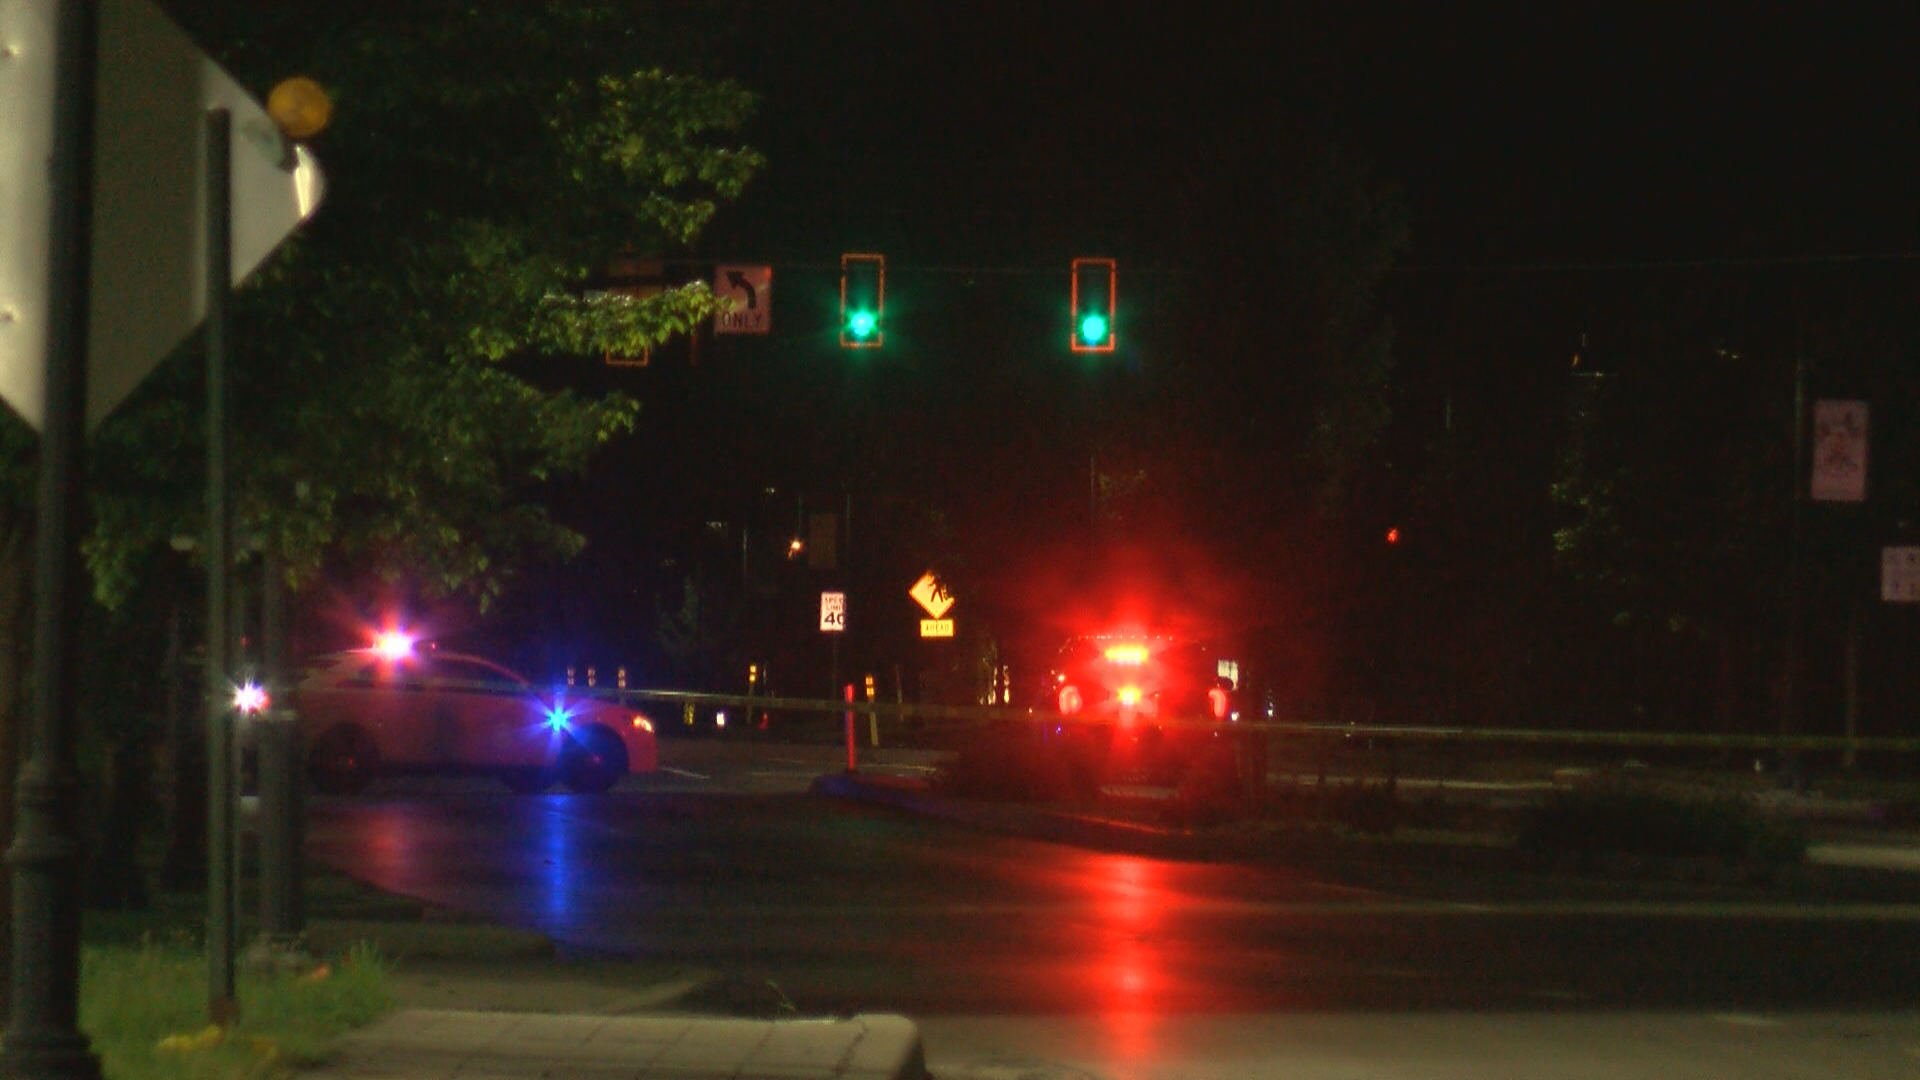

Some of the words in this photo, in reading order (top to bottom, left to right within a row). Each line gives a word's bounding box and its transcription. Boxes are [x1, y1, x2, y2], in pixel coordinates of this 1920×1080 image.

[722, 311, 762, 328] ONLY
[824, 612, 844, 625] 40
[925, 623, 949, 632] AHEAD
